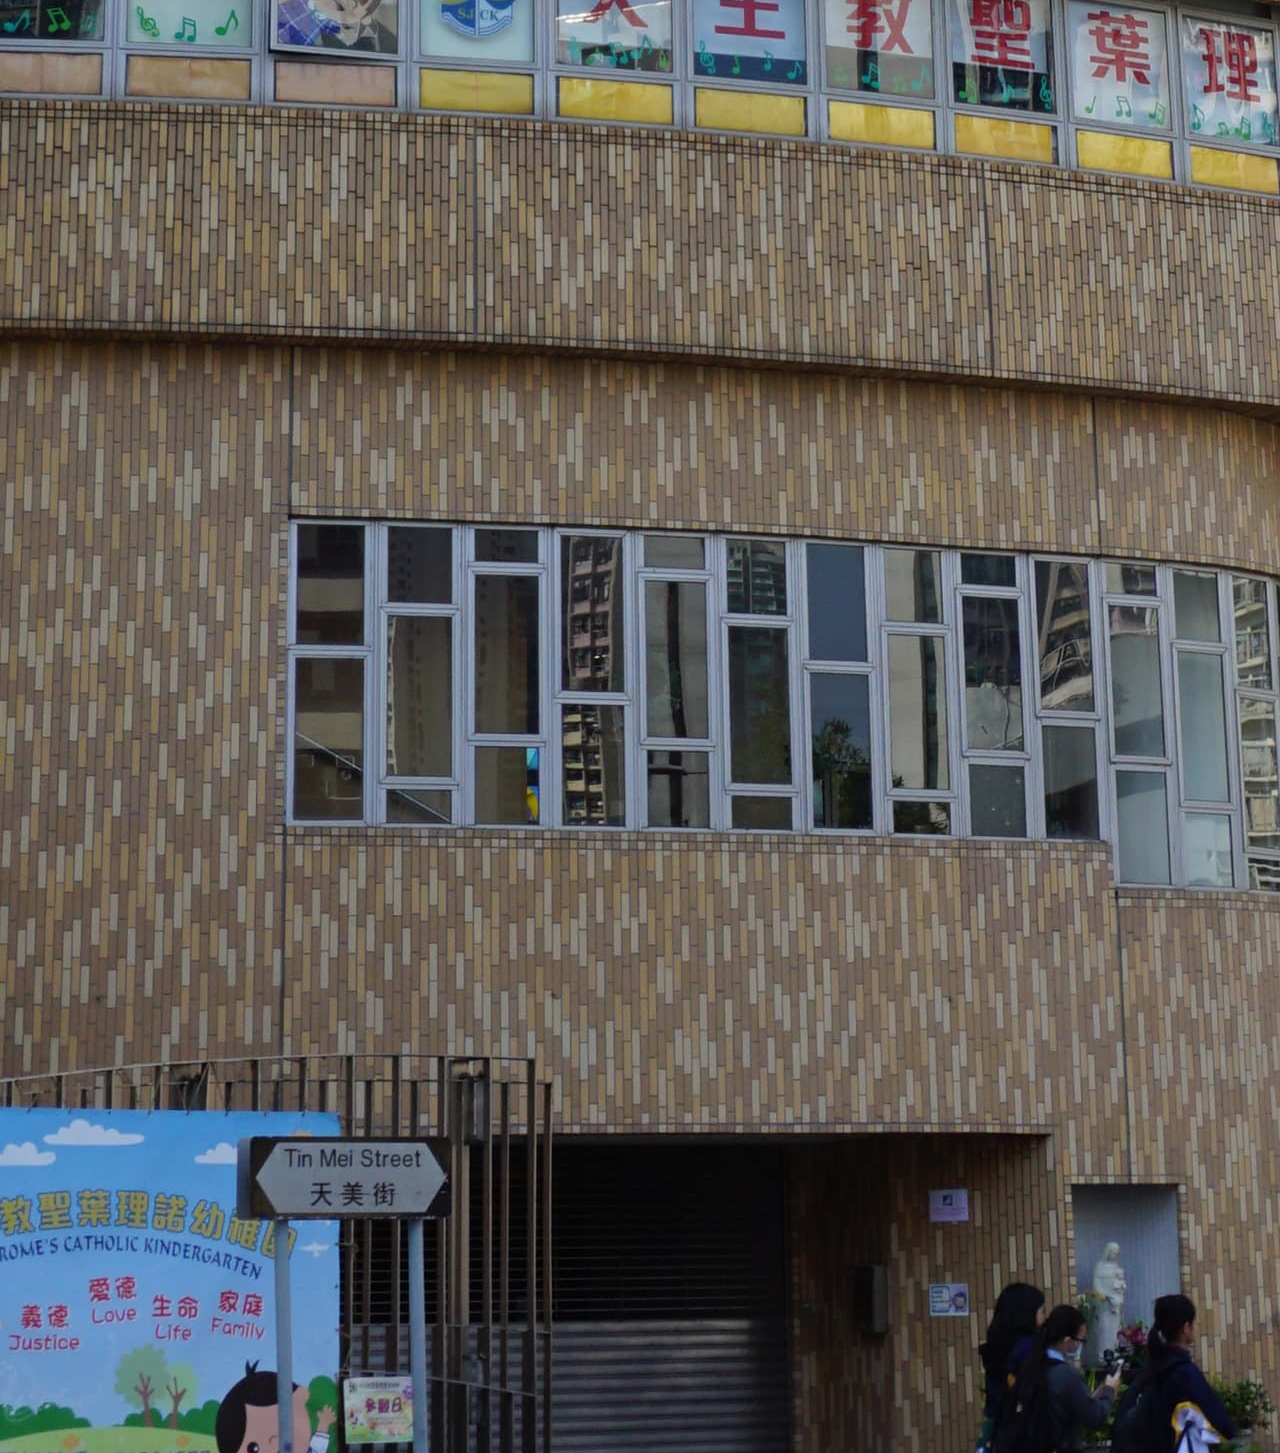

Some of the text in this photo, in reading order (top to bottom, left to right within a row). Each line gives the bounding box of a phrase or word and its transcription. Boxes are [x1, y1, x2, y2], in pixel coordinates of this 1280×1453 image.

[284, 1148, 422, 1168] Tin Mei Street
[310, 1181, 396, 1207] 天美街
[64, 1235, 139, 1253] CATHOLIC
[143, 1236, 263, 1280] KINDERGARTEN
[88, 1276, 137, 1303] 愛德
[21, 1304, 69, 1330] 義德
[92, 1307, 137, 1324] Love
[152, 1294, 199, 1320] 生命
[218, 1291, 264, 1317] 家庭
[155, 1323, 192, 1341] Life
[211, 1317, 265, 1341] Family
[8, 1334, 80, 1351] Justice
